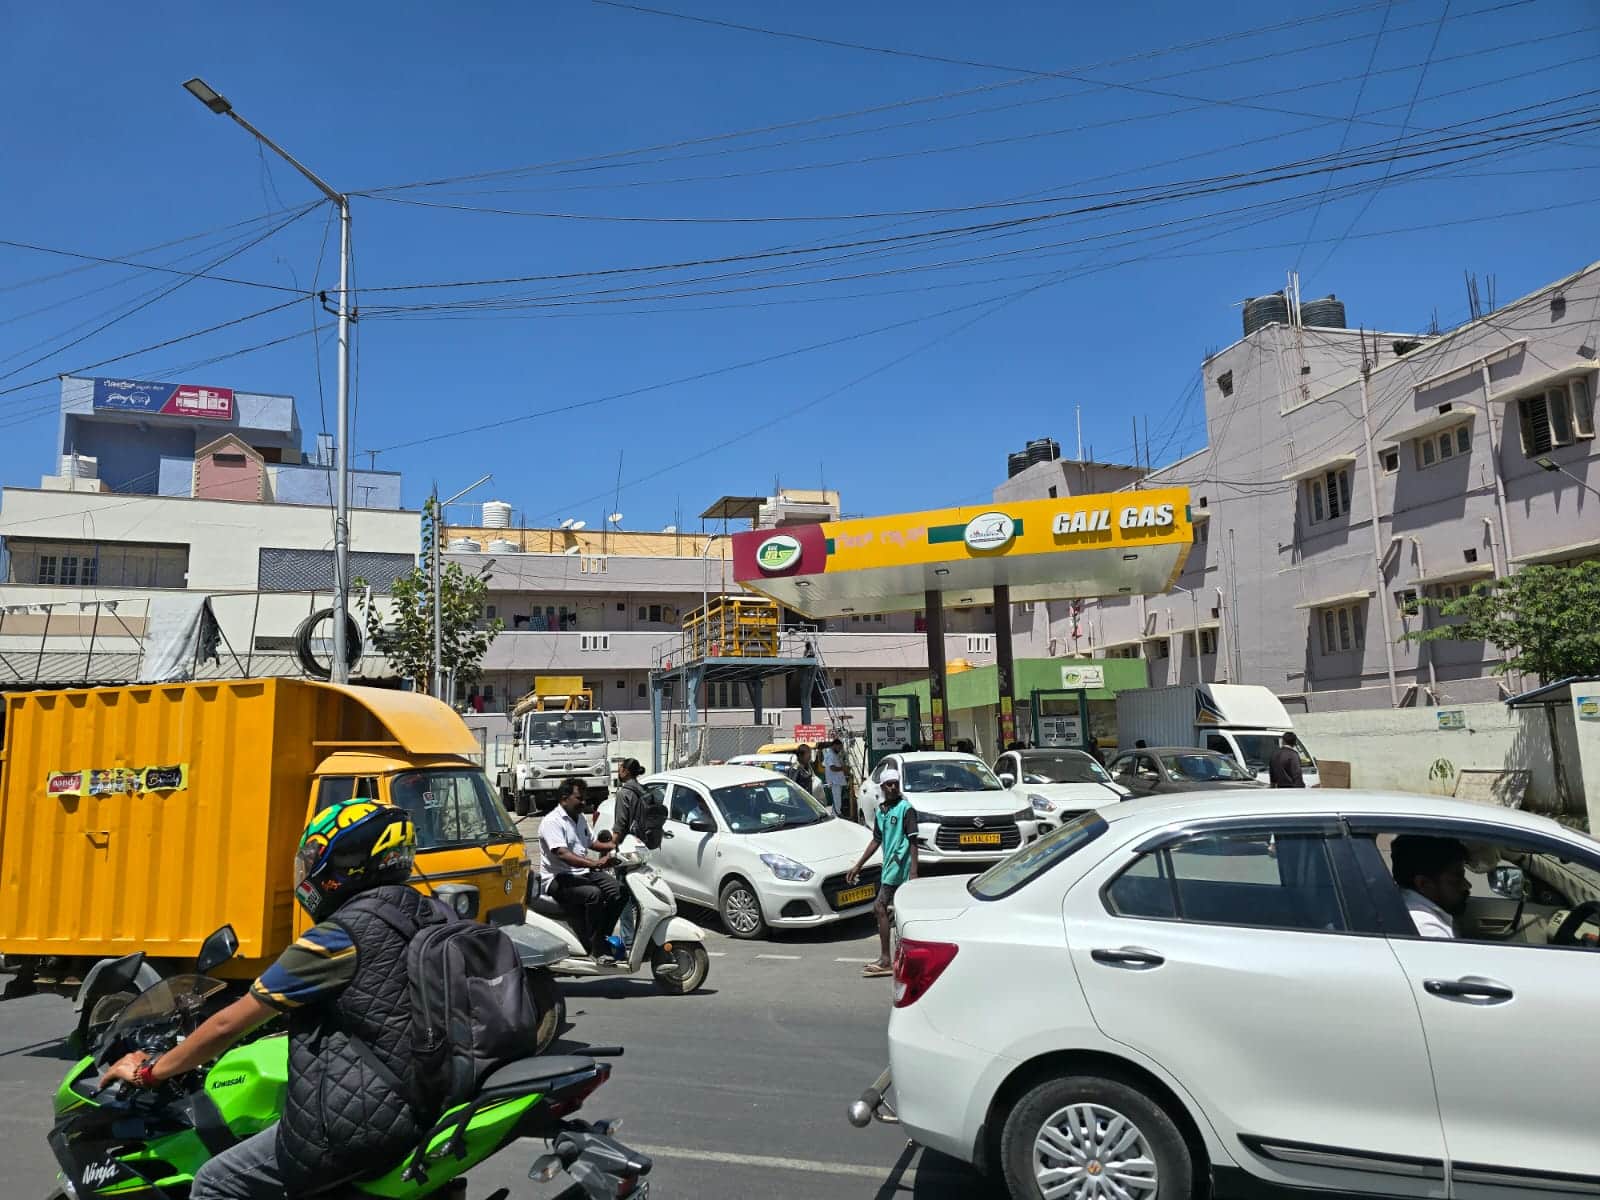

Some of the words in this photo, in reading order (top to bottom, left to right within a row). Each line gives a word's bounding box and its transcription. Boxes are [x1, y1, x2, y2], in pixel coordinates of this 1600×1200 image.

[1052, 509, 1111, 534] GAIL
[1119, 504, 1173, 529] GAS
[211, 1074, 247, 1090] Kawasaki
[82, 1159, 119, 1185] Ninja
